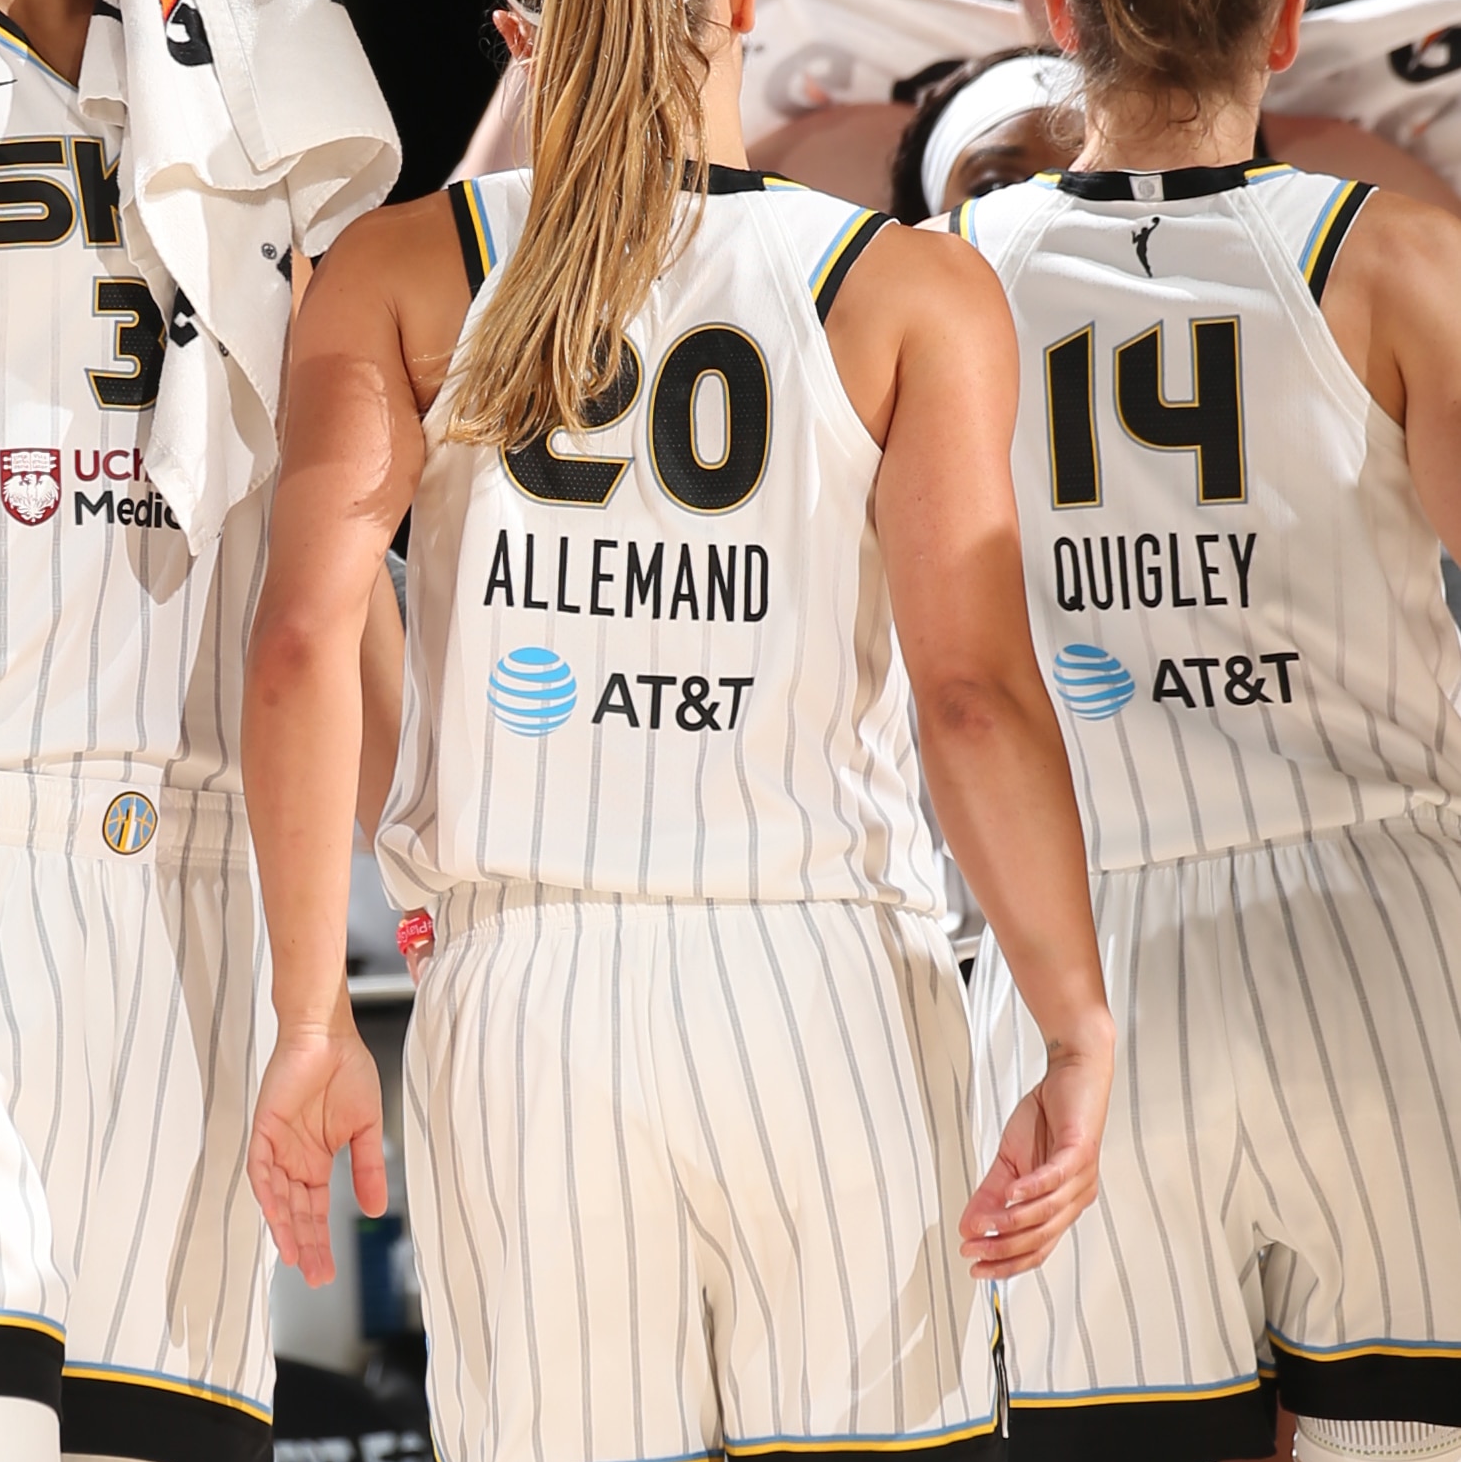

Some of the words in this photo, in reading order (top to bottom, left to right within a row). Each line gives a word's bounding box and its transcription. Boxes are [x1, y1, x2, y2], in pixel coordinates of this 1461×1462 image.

[499, 322, 773, 516] 20
[1043, 315, 1248, 510] 14
[483, 529, 769, 622] ALLEMAND
[1053, 532, 1258, 612] QUIGLEY
[591, 671, 755, 732] AT&T
[1151, 652, 1301, 708] AT&T
